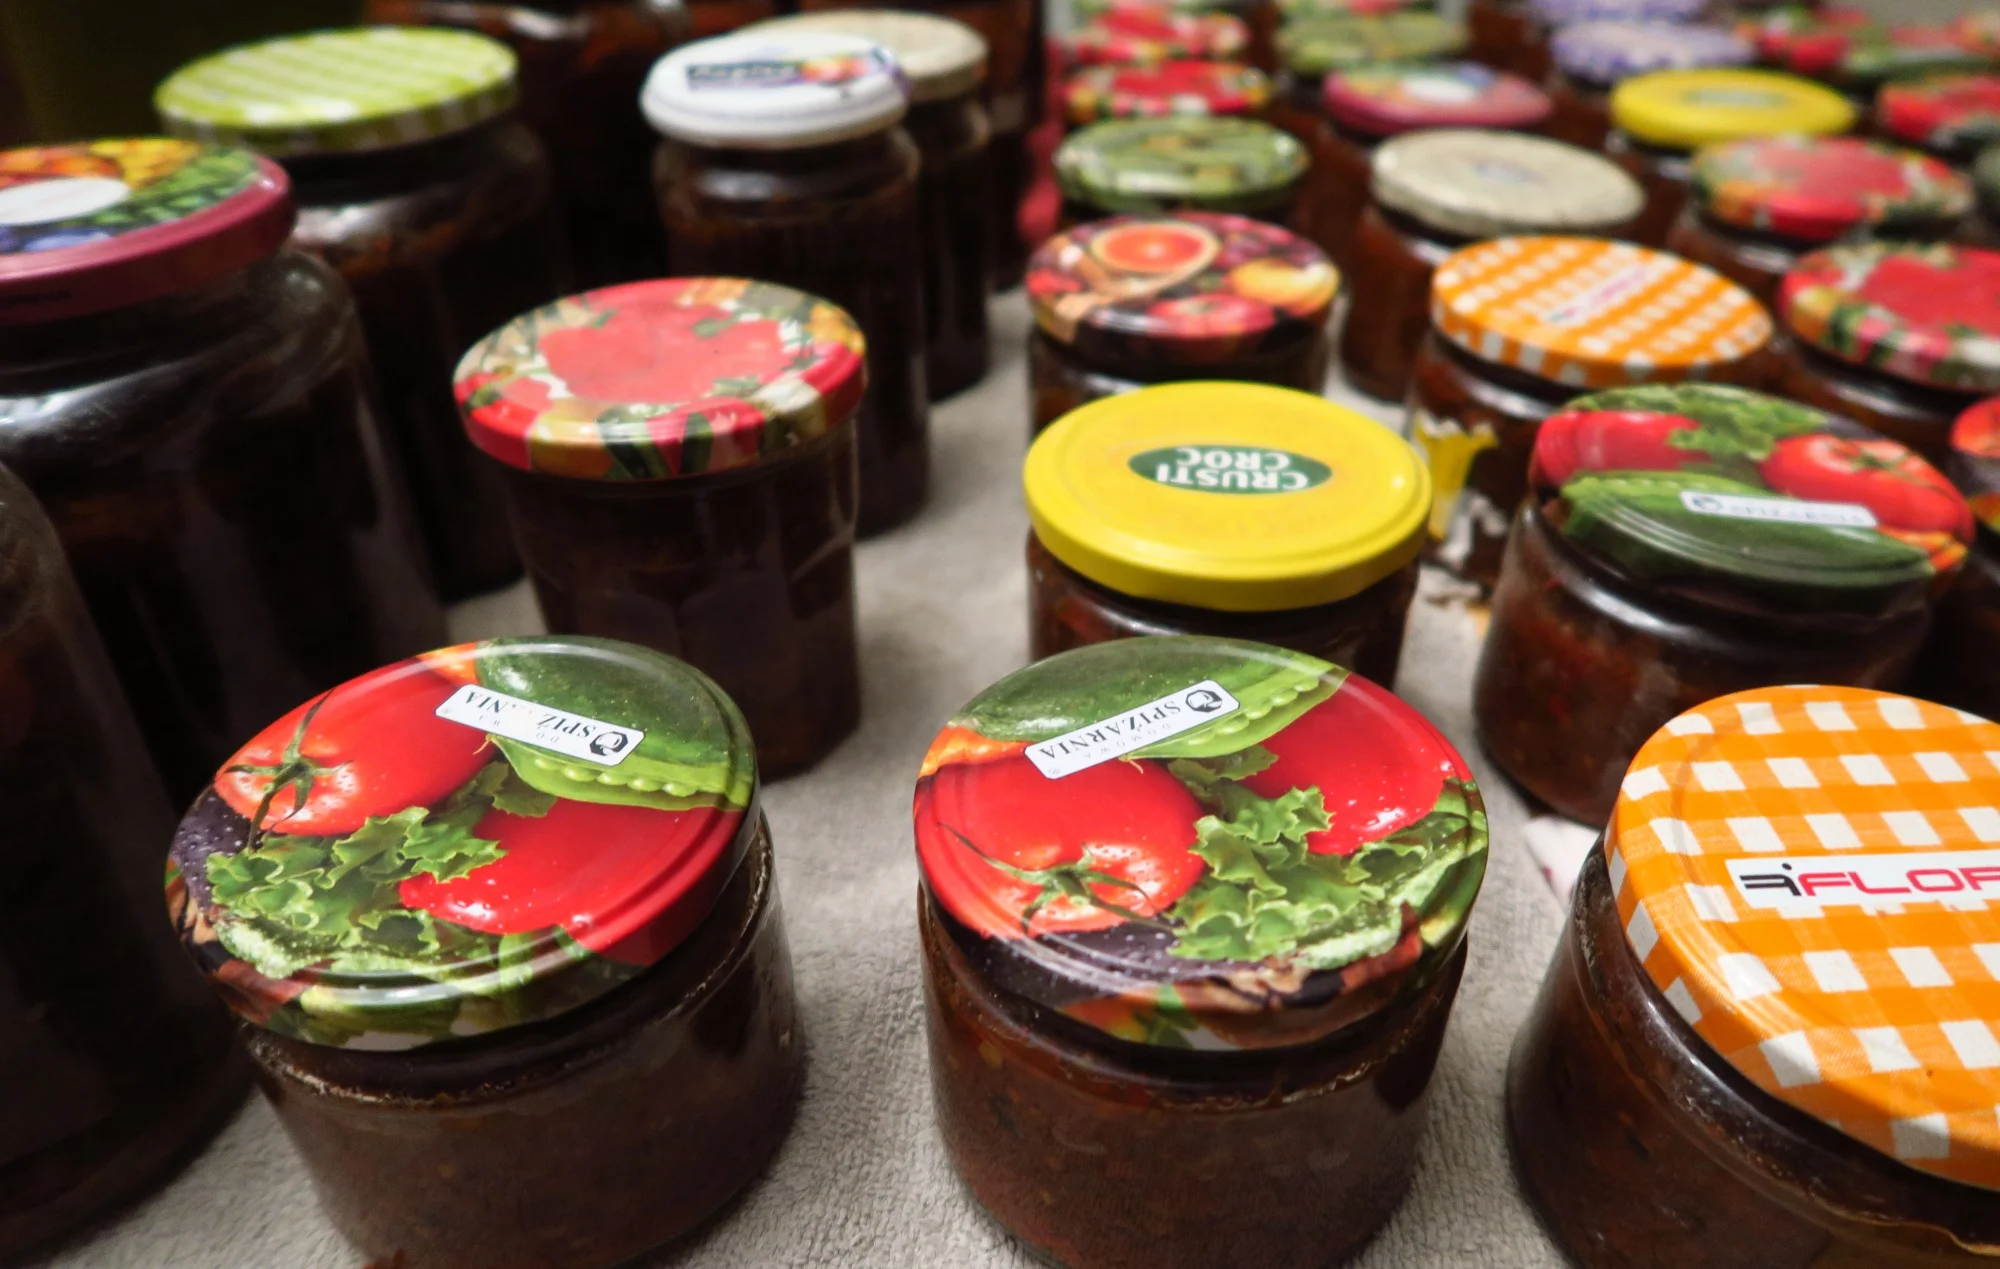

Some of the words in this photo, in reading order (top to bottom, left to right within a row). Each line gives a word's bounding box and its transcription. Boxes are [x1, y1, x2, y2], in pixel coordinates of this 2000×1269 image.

[1176, 447, 1291, 471] CROC
[1155, 463, 1309, 490] CRUSTI
[464, 691, 597, 739] SPIŻNIA
[478, 714, 560, 744] DOWA
